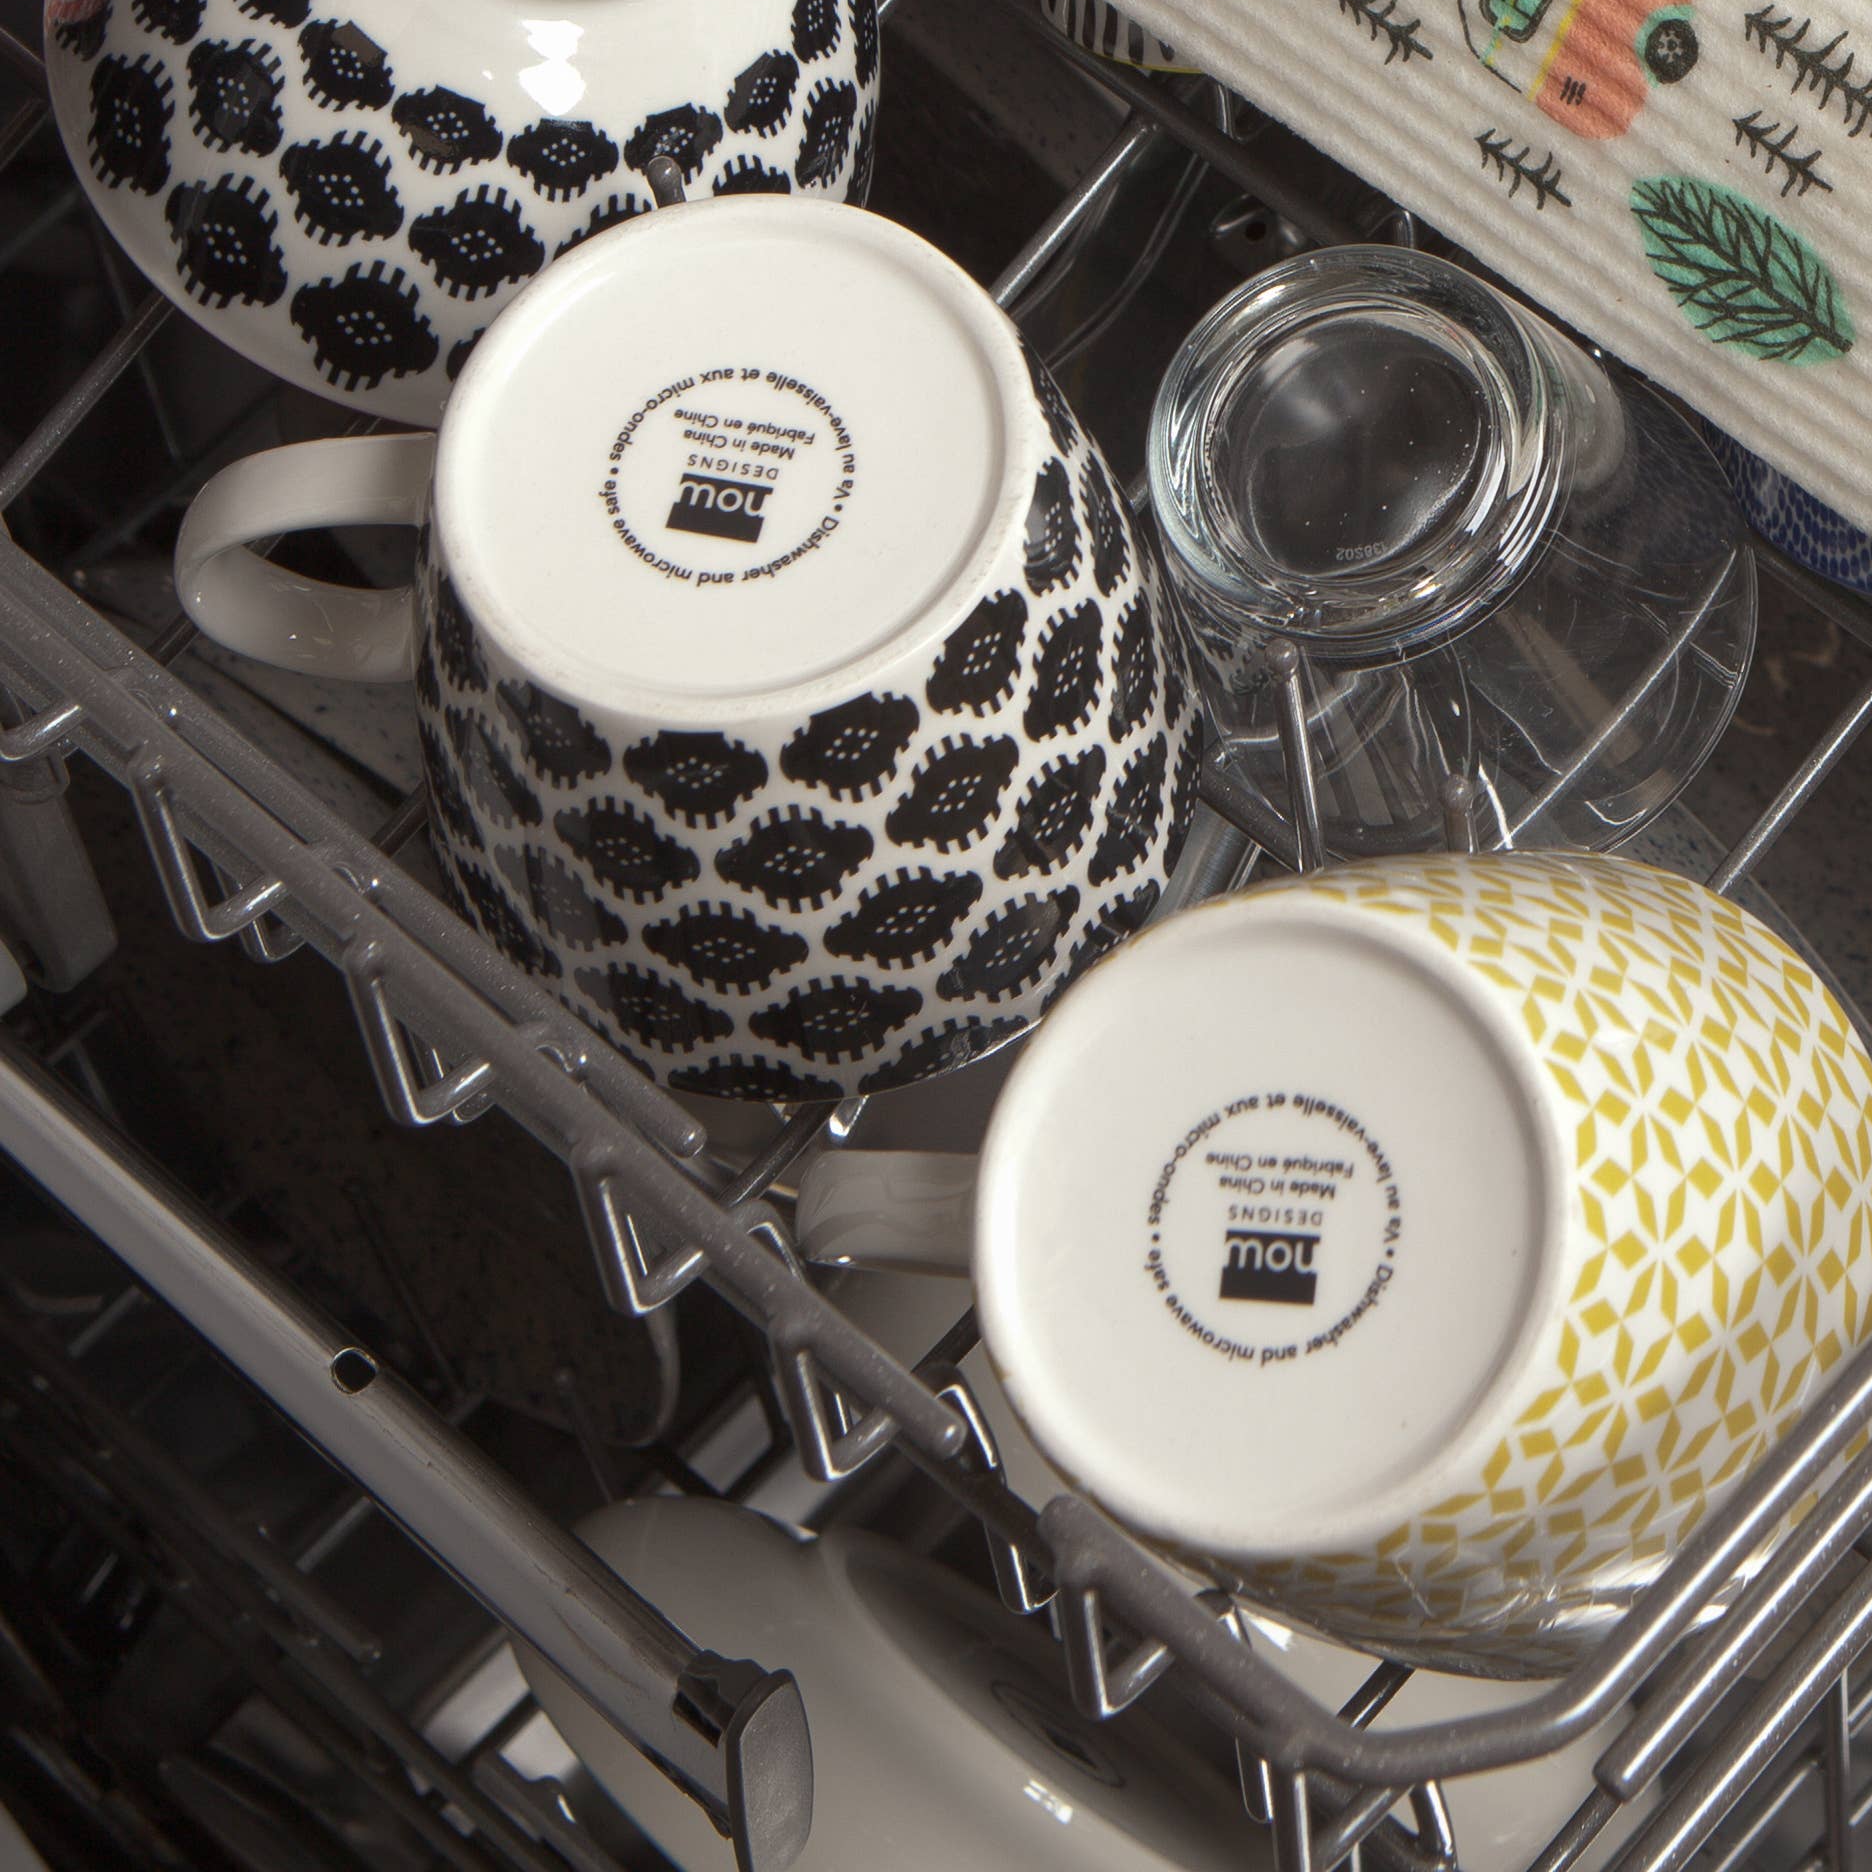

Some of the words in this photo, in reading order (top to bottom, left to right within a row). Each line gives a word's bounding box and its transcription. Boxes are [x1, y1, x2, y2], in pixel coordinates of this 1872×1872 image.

[699, 367, 735, 385] aux
[740, 367, 761, 382] et
[609, 376, 696, 462] micro-ondes
[673, 408, 720, 429] Chine
[765, 371, 852, 451] lave-vaisselle
[723, 418, 744, 430] en
[746, 422, 816, 446] Fabriqué
[683, 429, 728, 449] China
[731, 438, 748, 452] in
[749, 441, 796, 461] Made
[687, 453, 780, 481] DESIGNS
[842, 453, 856, 474] au
[598, 479, 621, 516] safe
[673, 479, 768, 519] now
[832, 479, 854, 500] Va
[612, 518, 693, 581] microwave
[741, 515, 840, 582] Dishwasher
[696, 571, 735, 588] and
[1223, 1095, 1260, 1119] aux
[1266, 1092, 1287, 1110] et
[1292, 1093, 1393, 1184] lave-vaisselle
[1147, 1112, 1222, 1226] micro-ondes
[1204, 1151, 1253, 1172] Chine
[1257, 1156, 1278, 1169] en
[1282, 1156, 1355, 1180] Fabriqué
[1218, 1175, 1266, 1195] China
[1269, 1179, 1286, 1196] in
[1288, 1180, 1337, 1201] Made
[1385, 1184, 1401, 1211] au
[1227, 1203, 1324, 1227] DESIGNS
[1383, 1216, 1402, 1244] Va
[1221, 1234, 1320, 1276] now
[1143, 1248, 1170, 1292] safe
[1305, 1264, 1394, 1355] Dishwasher
[1165, 1294, 1256, 1361] microwave
[1260, 1344, 1298, 1367] and
